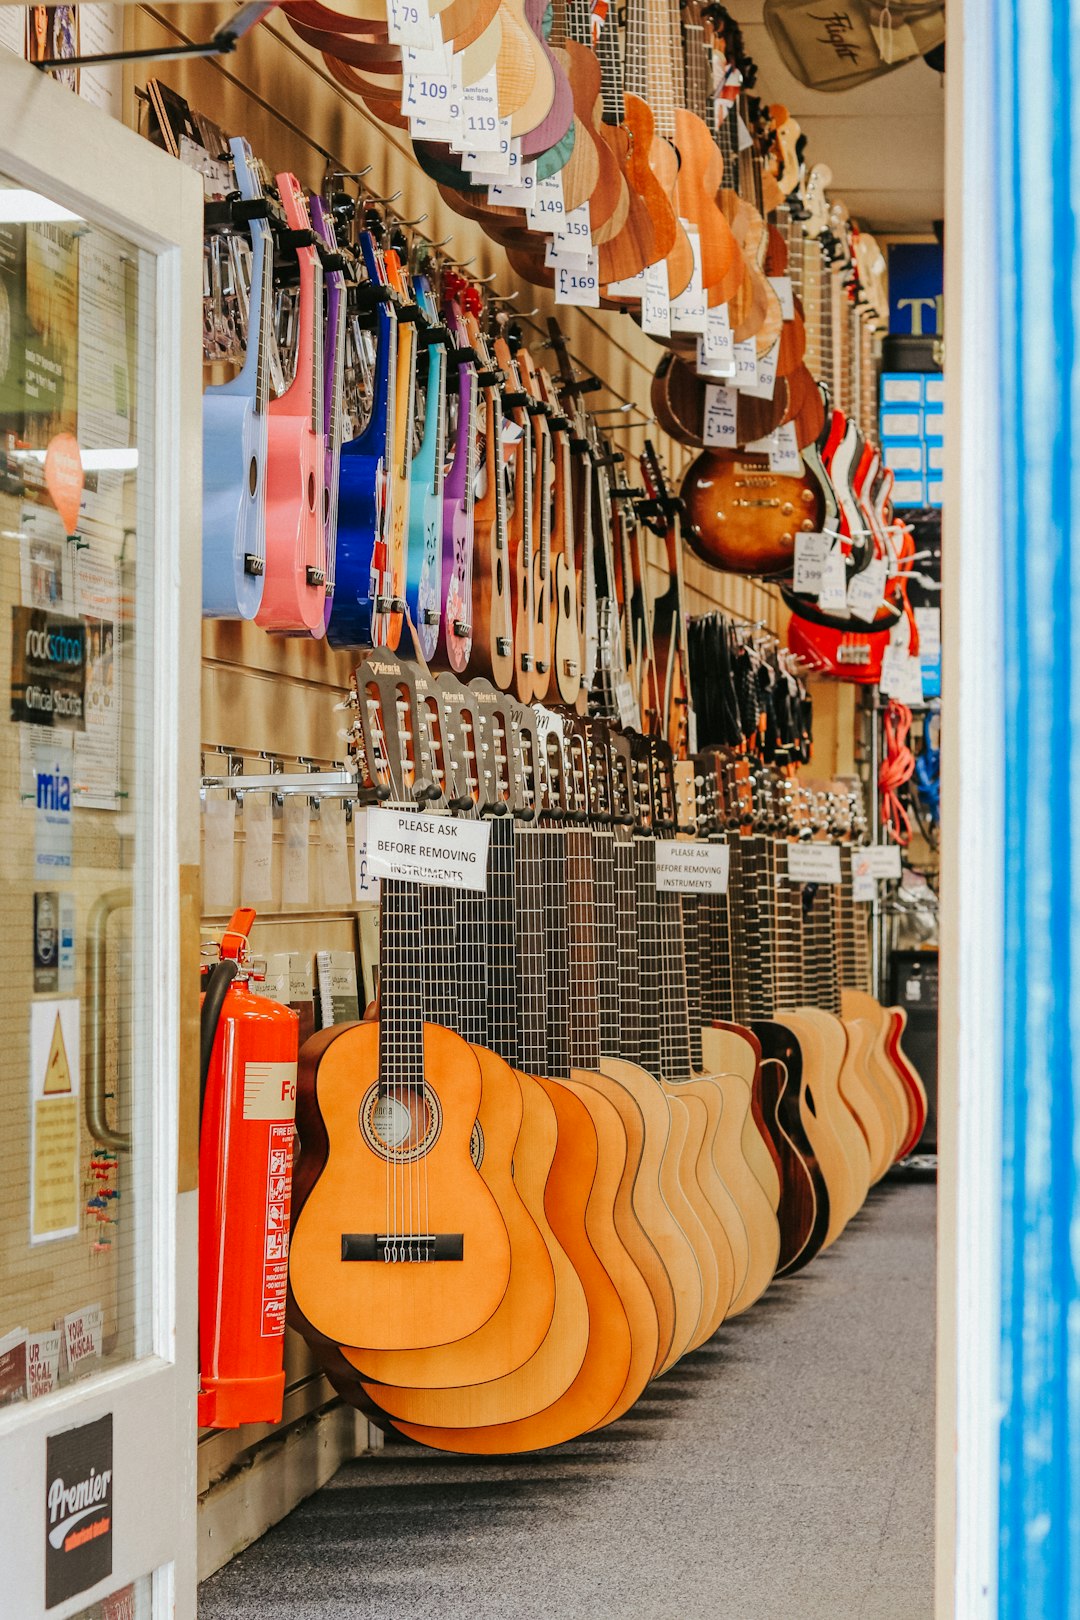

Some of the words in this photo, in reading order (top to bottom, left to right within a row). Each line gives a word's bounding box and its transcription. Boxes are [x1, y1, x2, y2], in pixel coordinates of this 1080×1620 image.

[402, 6, 418, 23] 79
[806, 11, 861, 66] Flight
[420, 81, 447, 99] 109
[468, 116, 496, 131] 119
[540, 200, 563, 213] 149
[566, 222, 589, 236] 159
[570, 276, 595, 289] 169
[652, 306, 668, 319] 199
[713, 336, 729, 347] 159
[738, 361, 756, 372] 179
[717, 424, 735, 434] 199
[398, 819, 435, 834] PLEASE
[437, 824, 458, 837] ASK
[377, 840, 416, 856] BEFORE
[419, 845, 476, 863] REMOVING
[671, 848, 694, 857] PLEASE
[696, 849, 709, 857] ASK
[390, 862, 463, 882] INSTRUMENTS
[656, 863, 682, 872] BEFORE
[684, 864, 722, 875] REMOVING
[663, 879, 712, 888] INSTRUMENTS
[68, 1319, 83, 1341] YOUR
[48, 1467, 112, 1523] Premier
